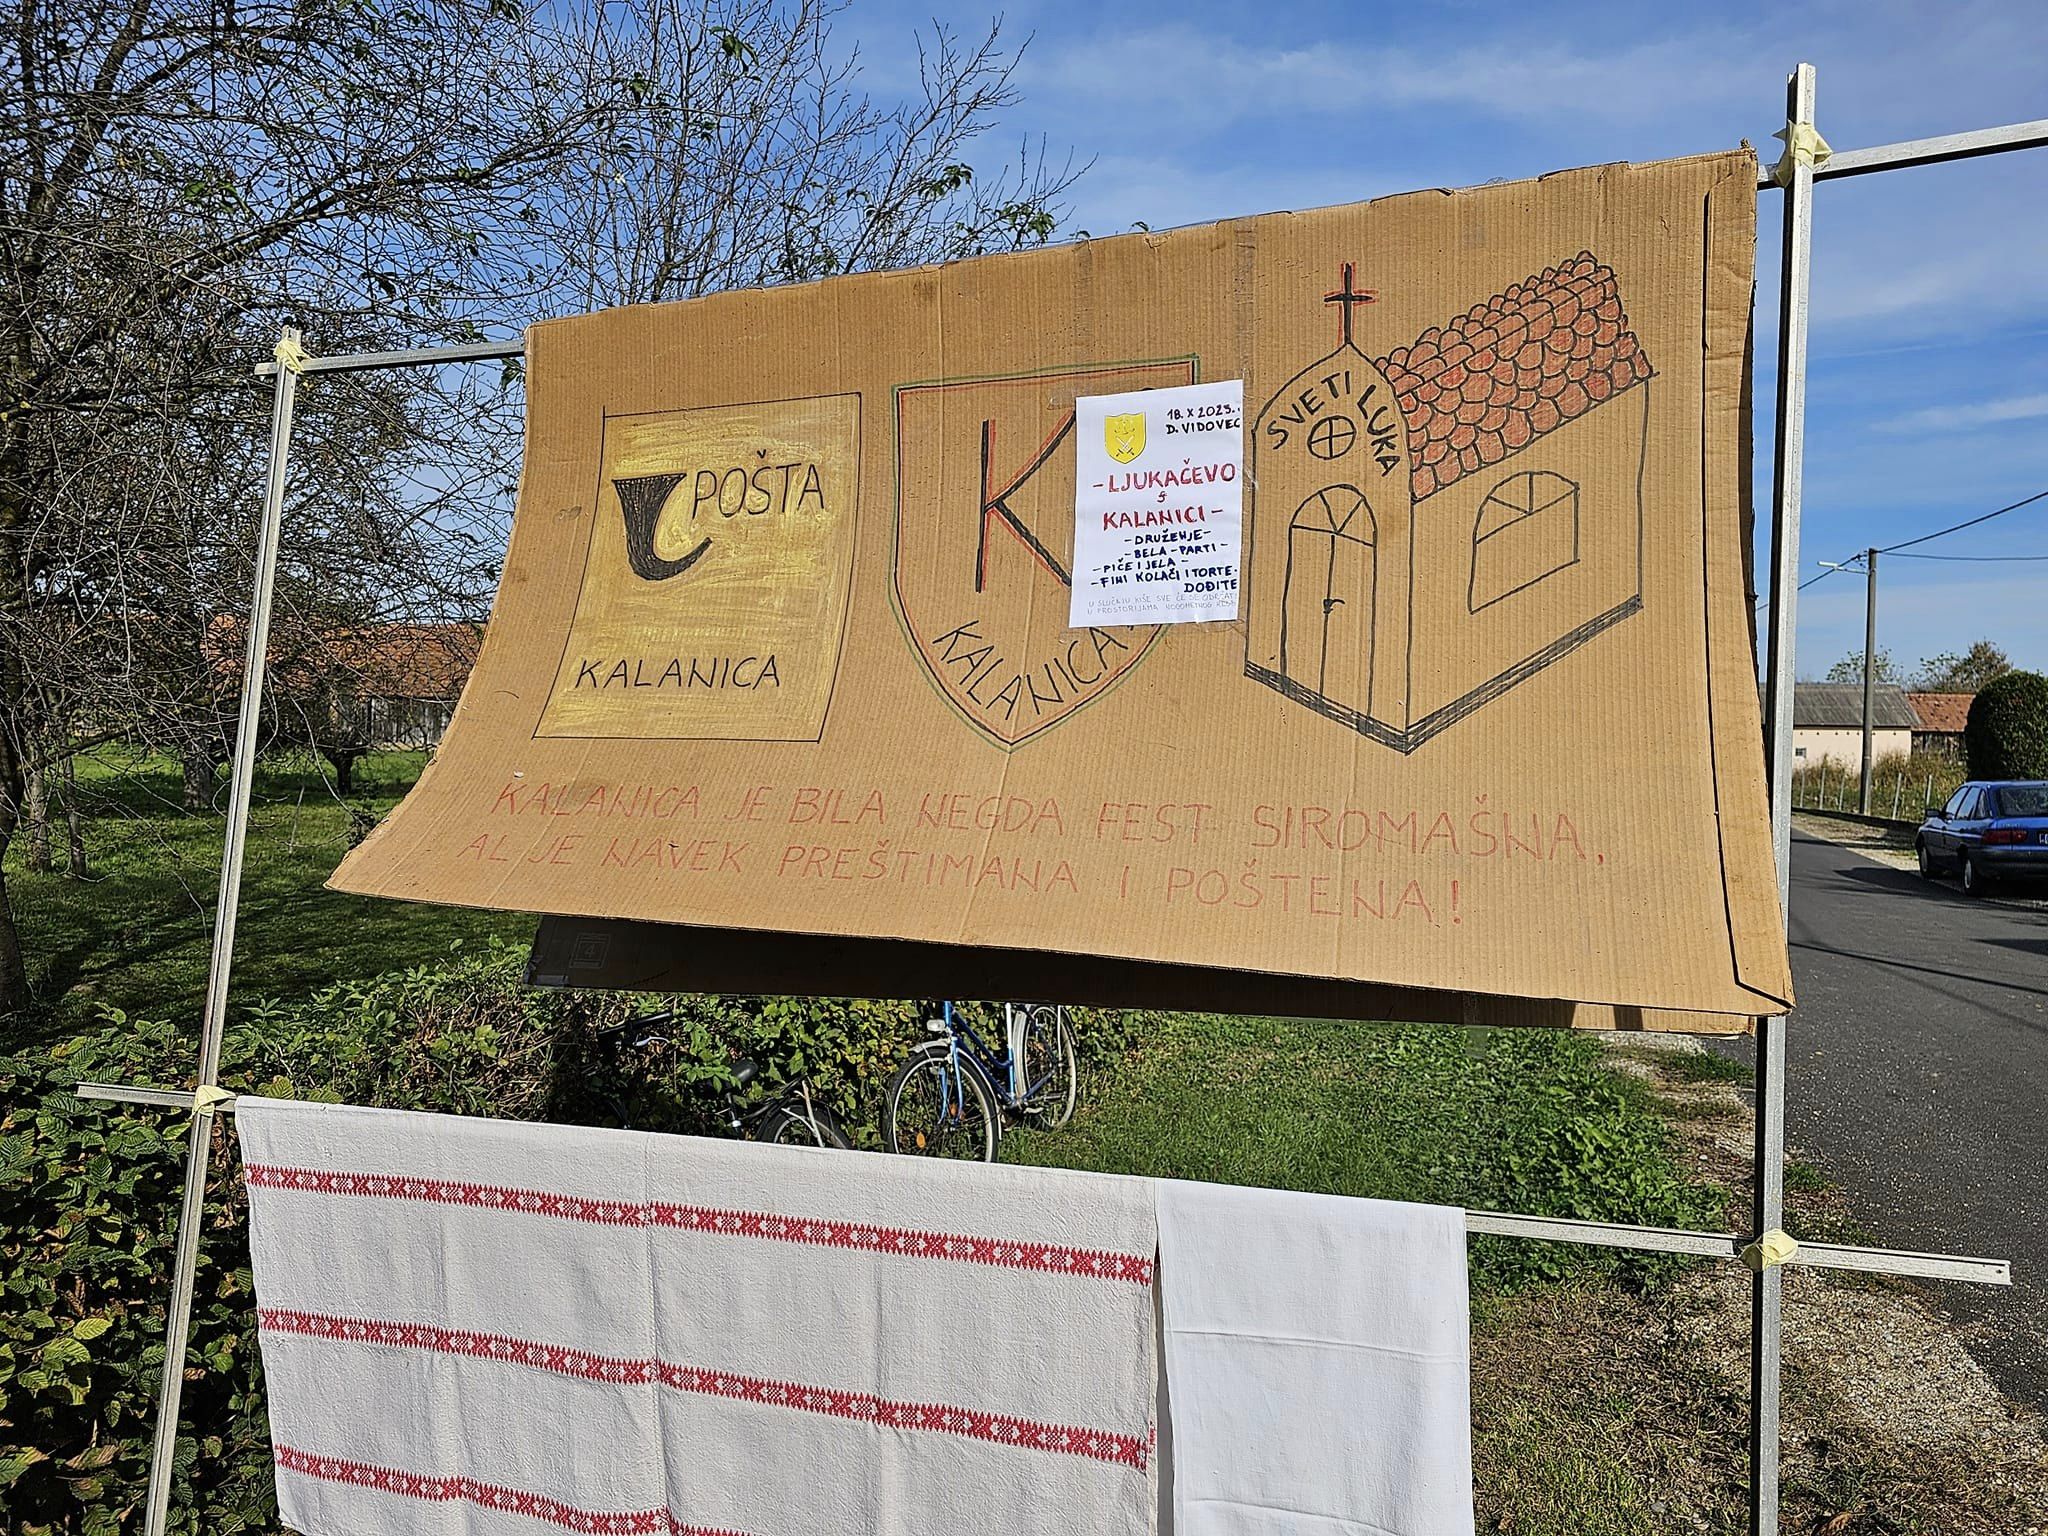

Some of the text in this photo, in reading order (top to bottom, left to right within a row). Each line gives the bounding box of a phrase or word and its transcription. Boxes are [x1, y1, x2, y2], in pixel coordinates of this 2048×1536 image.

[1166, 418, 1240, 435] D. VIDOVEC
[1167, 408, 1184, 420] 18.
[1266, 370, 1401, 477] SVETI LUKA
[692, 449, 825, 520] POŠTA
[1135, 568, 1180, 583] KOLAČI
[1184, 579, 1238, 593] DOĐITE
[574, 654, 781, 691] KALANICA
[932, 619, 1129, 721] KALANICA
[490, 781, 700, 820] KALANICA
[723, 786, 775, 821] JE
[788, 787, 885, 825] BILA
[916, 792, 1063, 837] NEGDA
[1097, 802, 1212, 844] FEST
[457, 833, 1462, 925] AL JE NAVEK PREŠTIMANA I POŠTENA!
